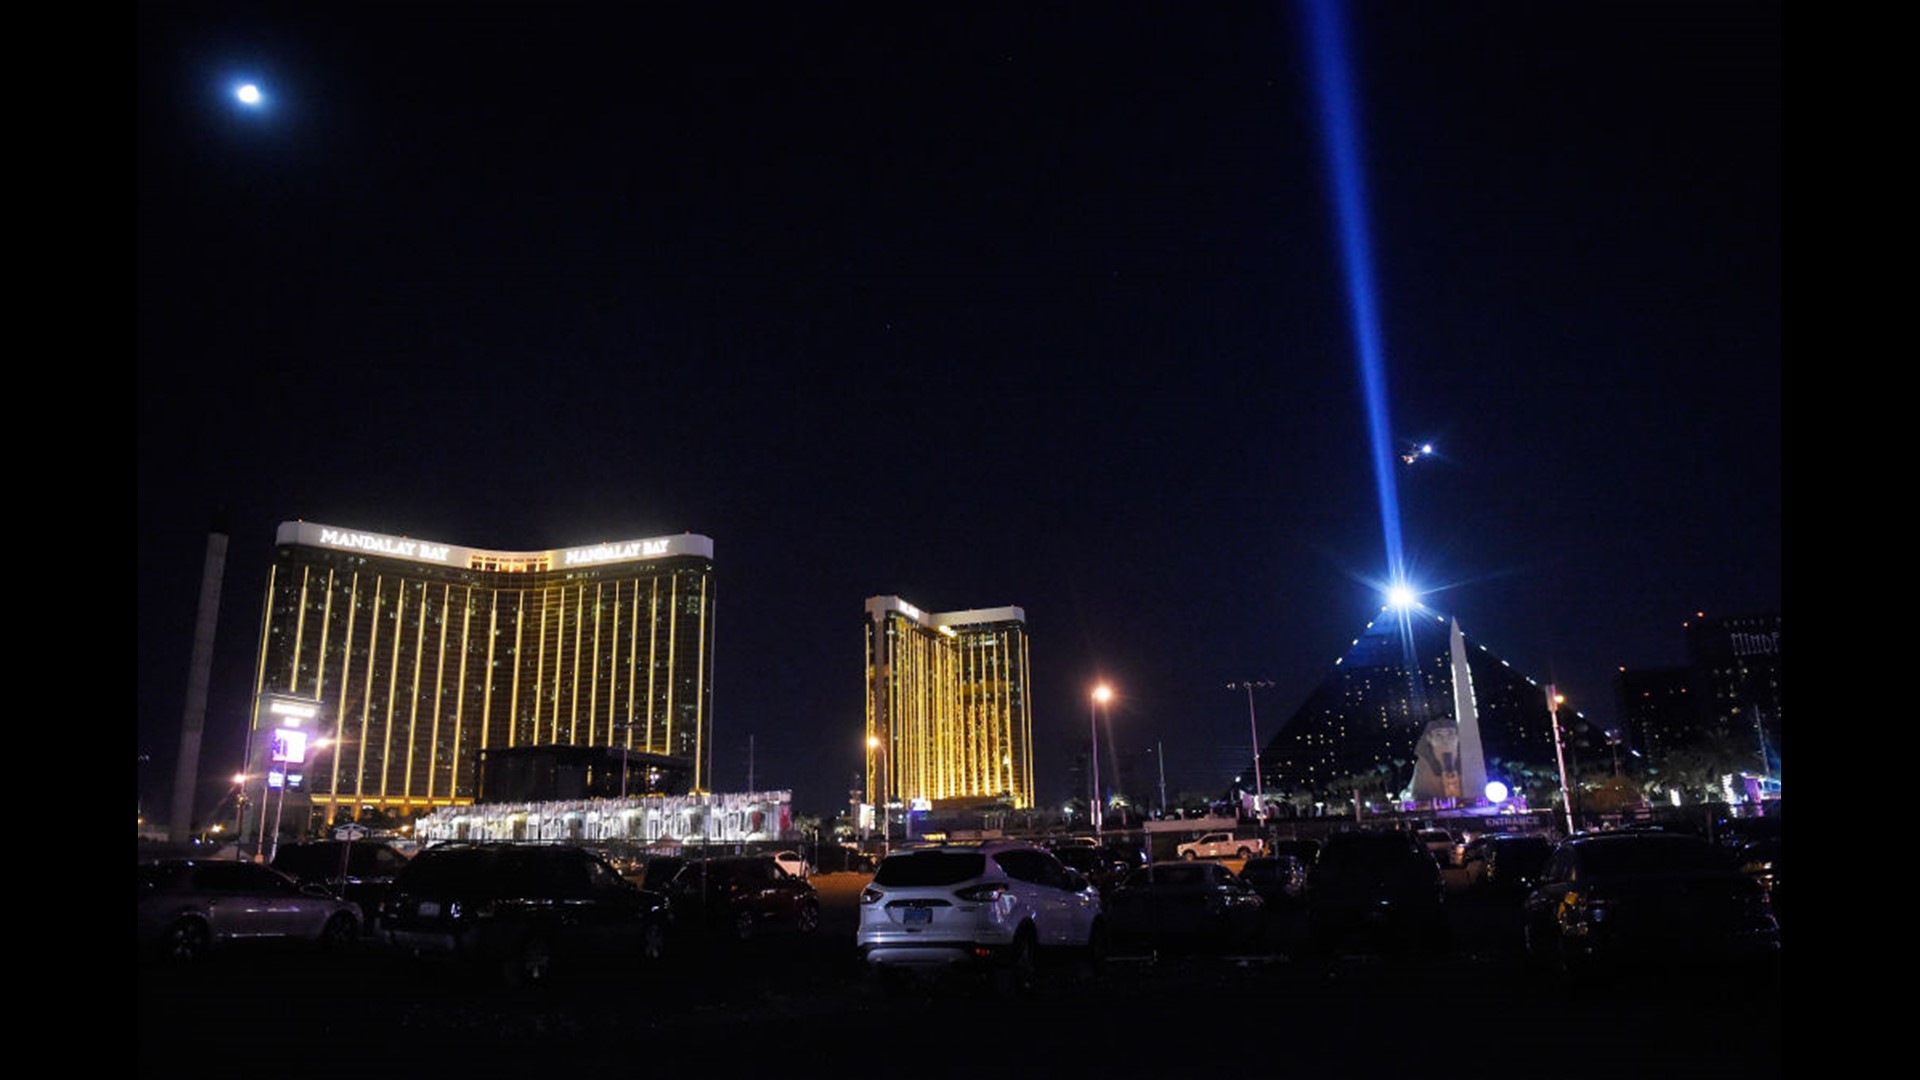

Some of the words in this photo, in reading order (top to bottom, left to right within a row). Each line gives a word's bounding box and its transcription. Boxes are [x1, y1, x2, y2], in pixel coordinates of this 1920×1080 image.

[320, 529, 416, 556] MANDALAY
[419, 544, 450, 561] BAY
[565, 543, 641, 565] MANDALAY
[642, 539, 670, 555] BAY
[1485, 816, 1541, 828] ENTRANCE
